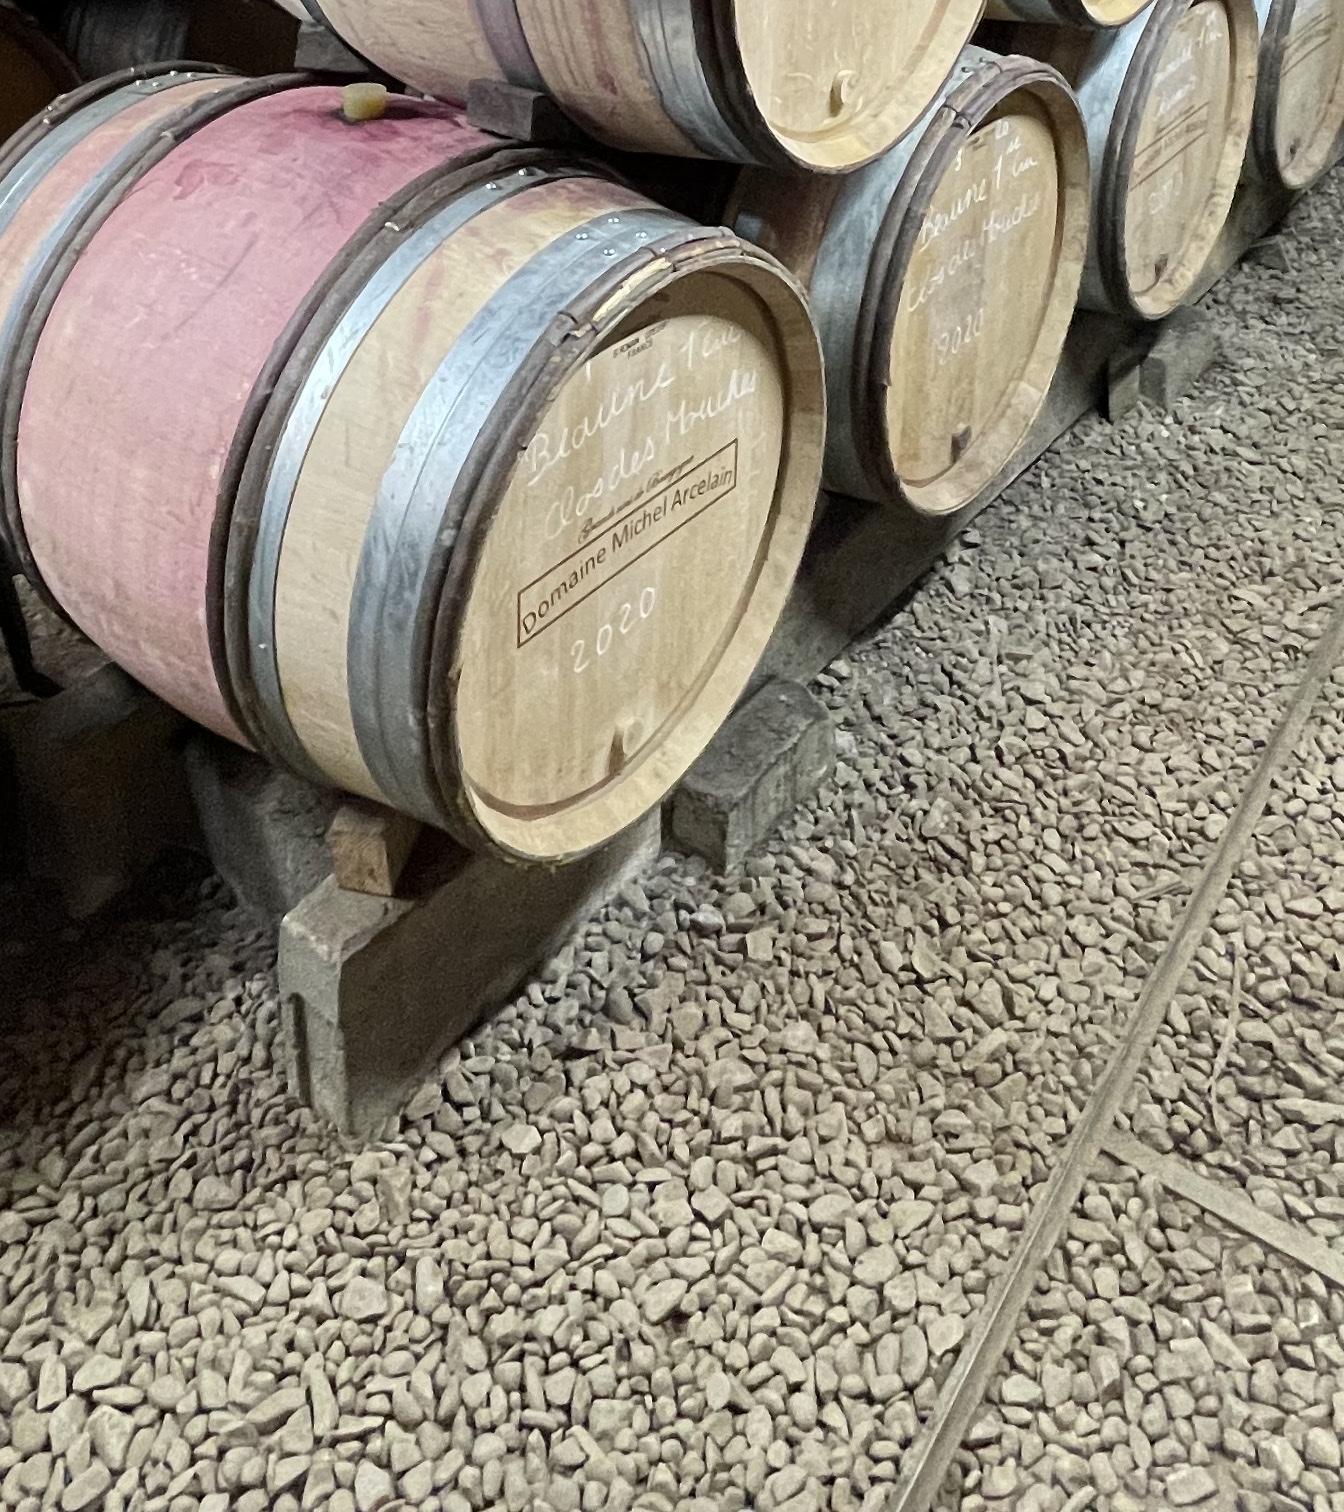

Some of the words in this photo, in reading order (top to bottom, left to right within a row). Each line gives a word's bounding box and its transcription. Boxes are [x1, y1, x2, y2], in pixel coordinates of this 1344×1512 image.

[528, 362, 676, 486] Beaune
[521, 547, 606, 636] Domaine
[611, 496, 668, 552] Michel
[670, 467, 734, 512] Arcelain
[570, 586, 656, 674] 2020
